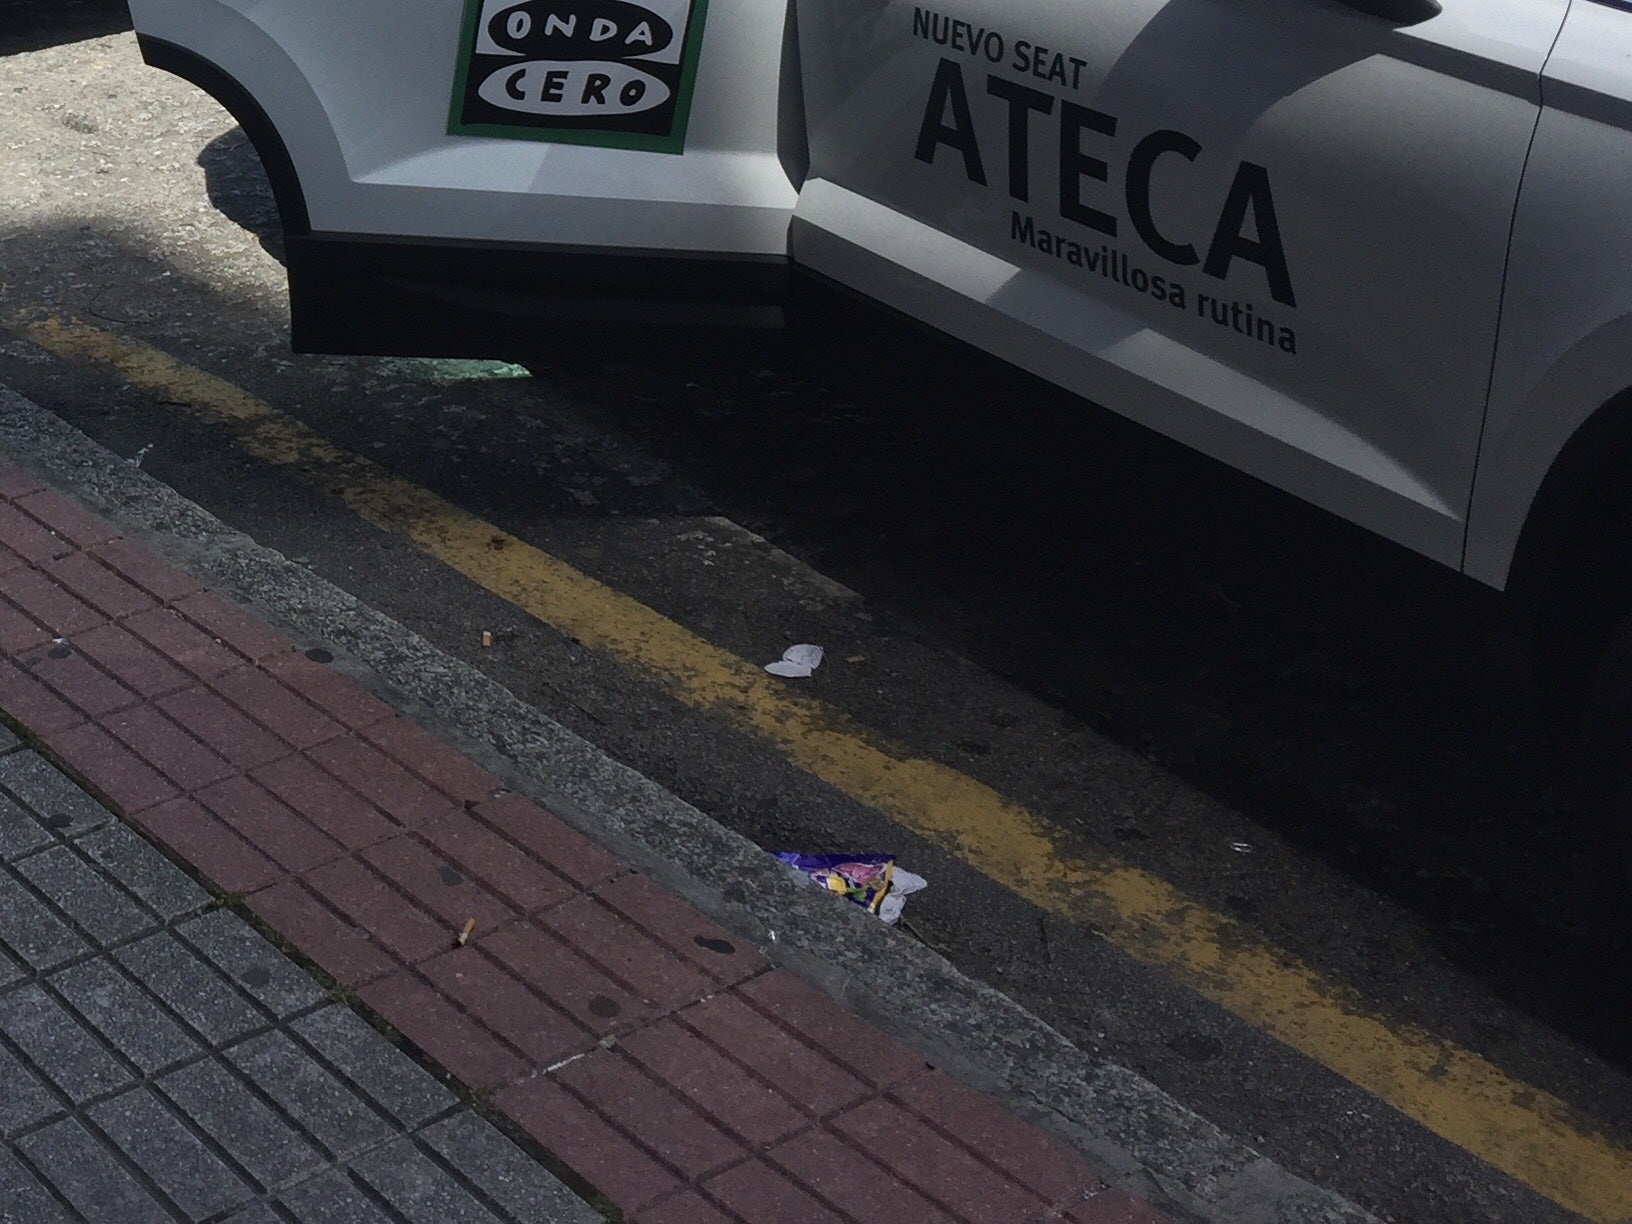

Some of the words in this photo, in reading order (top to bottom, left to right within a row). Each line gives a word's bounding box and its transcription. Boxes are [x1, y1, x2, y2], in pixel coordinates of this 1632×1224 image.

[506, 10, 653, 46] ONDA
[912, 6, 1005, 64] NUEVO
[1011, 39, 1088, 91] SEAT
[504, 68, 647, 107] CERO
[913, 56, 1297, 309] ATECA
[1010, 208, 1186, 311] Maravillosa
[1196, 291, 1297, 356] rutina
